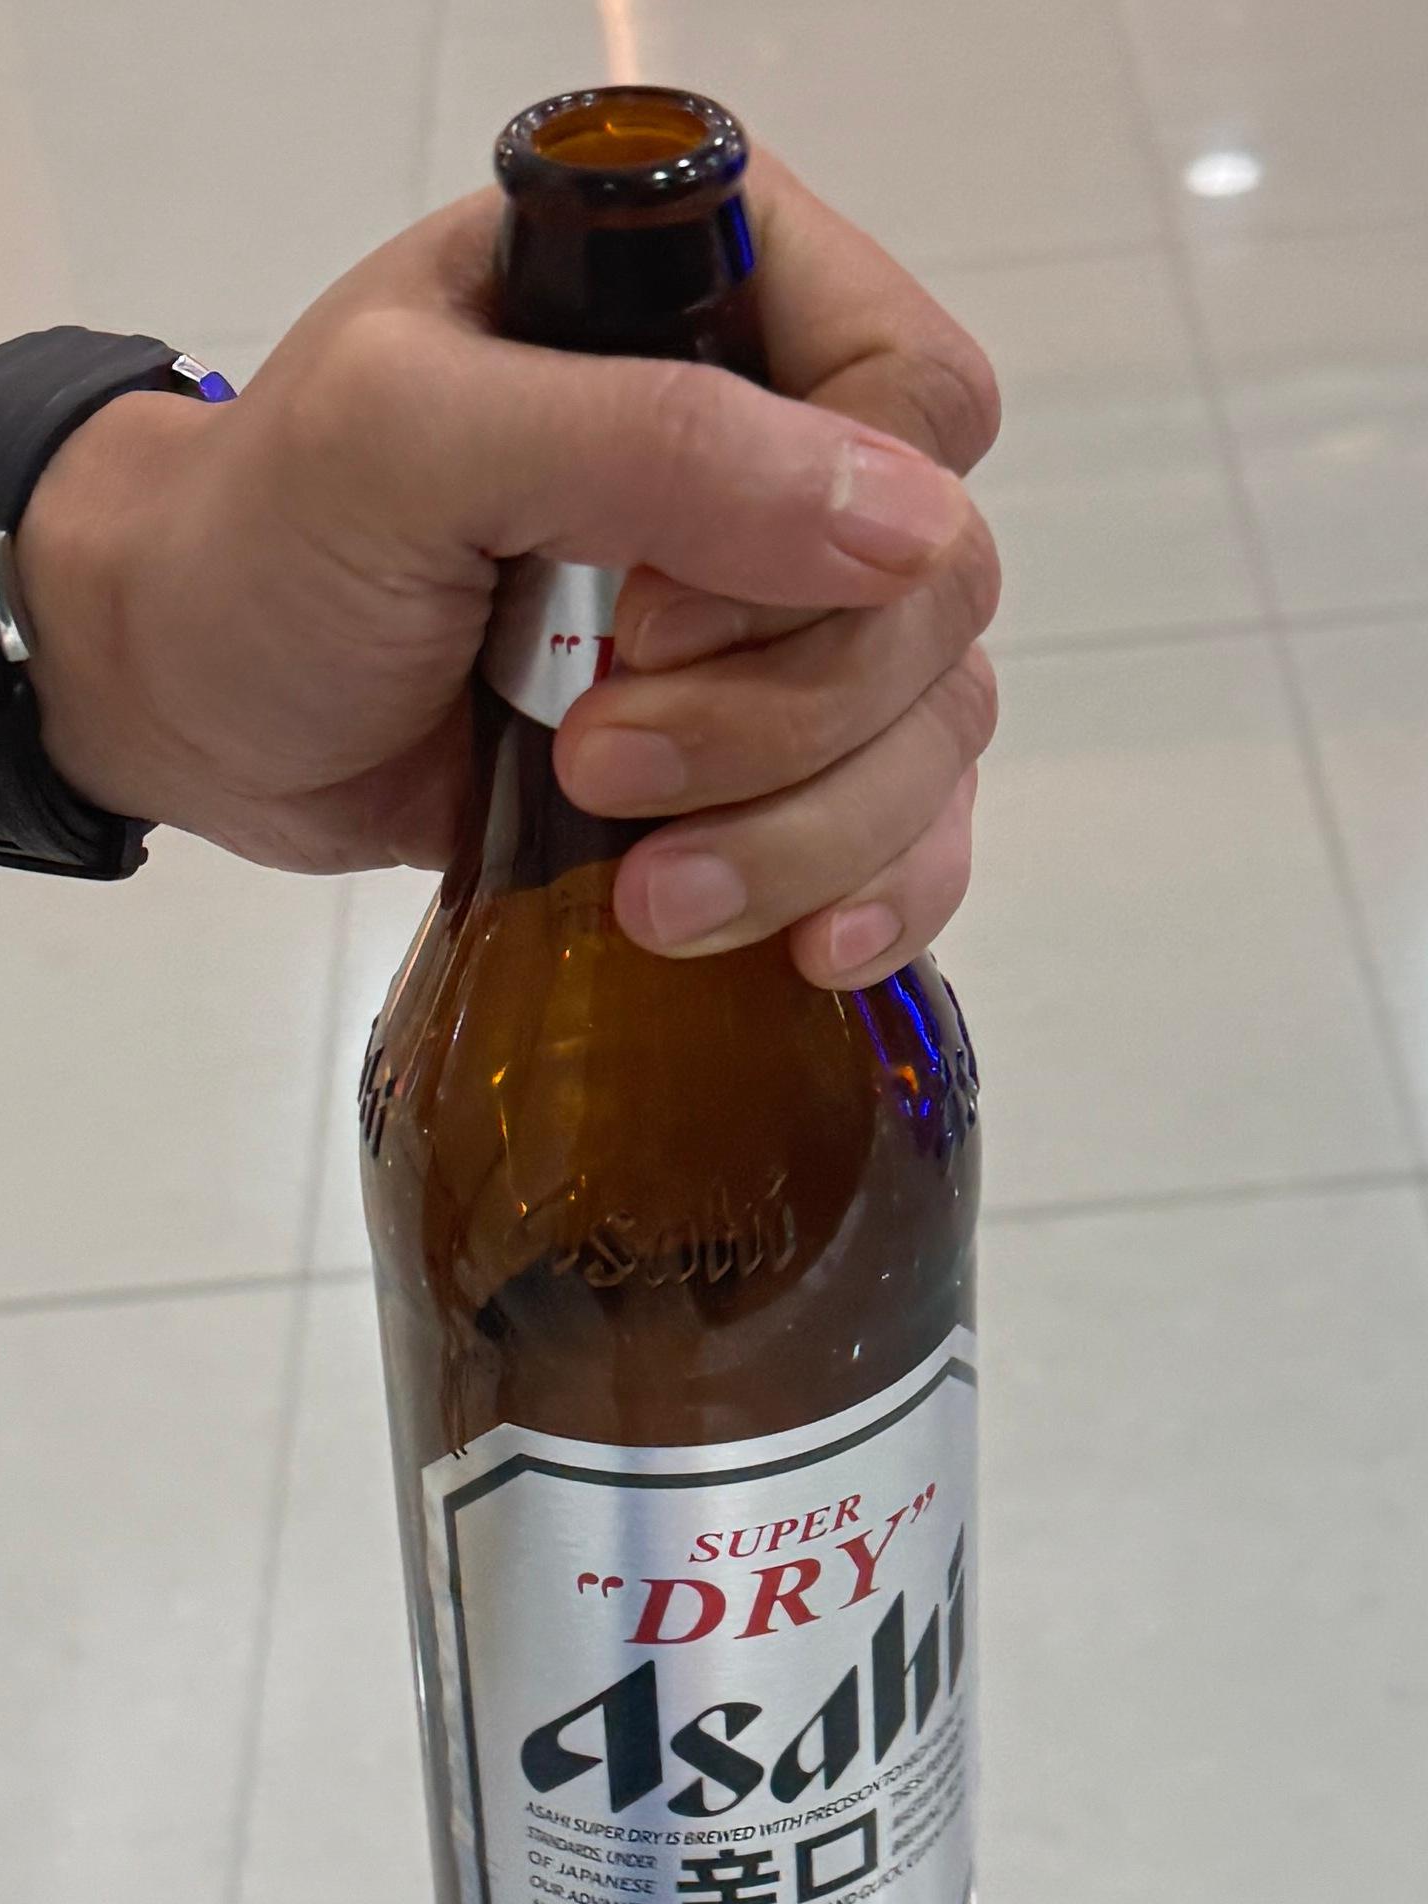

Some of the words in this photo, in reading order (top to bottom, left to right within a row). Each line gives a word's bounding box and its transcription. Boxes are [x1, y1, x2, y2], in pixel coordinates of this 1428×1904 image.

[688, 1493, 863, 1563] SUPER
[520, 1522, 966, 1818] Asahi
[573, 1817, 626, 1841] SUPER
[627, 1828, 662, 1845] DRY
[665, 1831, 681, 1845] IS
[683, 1825, 756, 1846] BREWED
[759, 1814, 803, 1837] WITH
[528, 1850, 554, 1869] OF
[556, 1862, 658, 1895] JAPANESE
[529, 1874, 566, 1900] OUR
